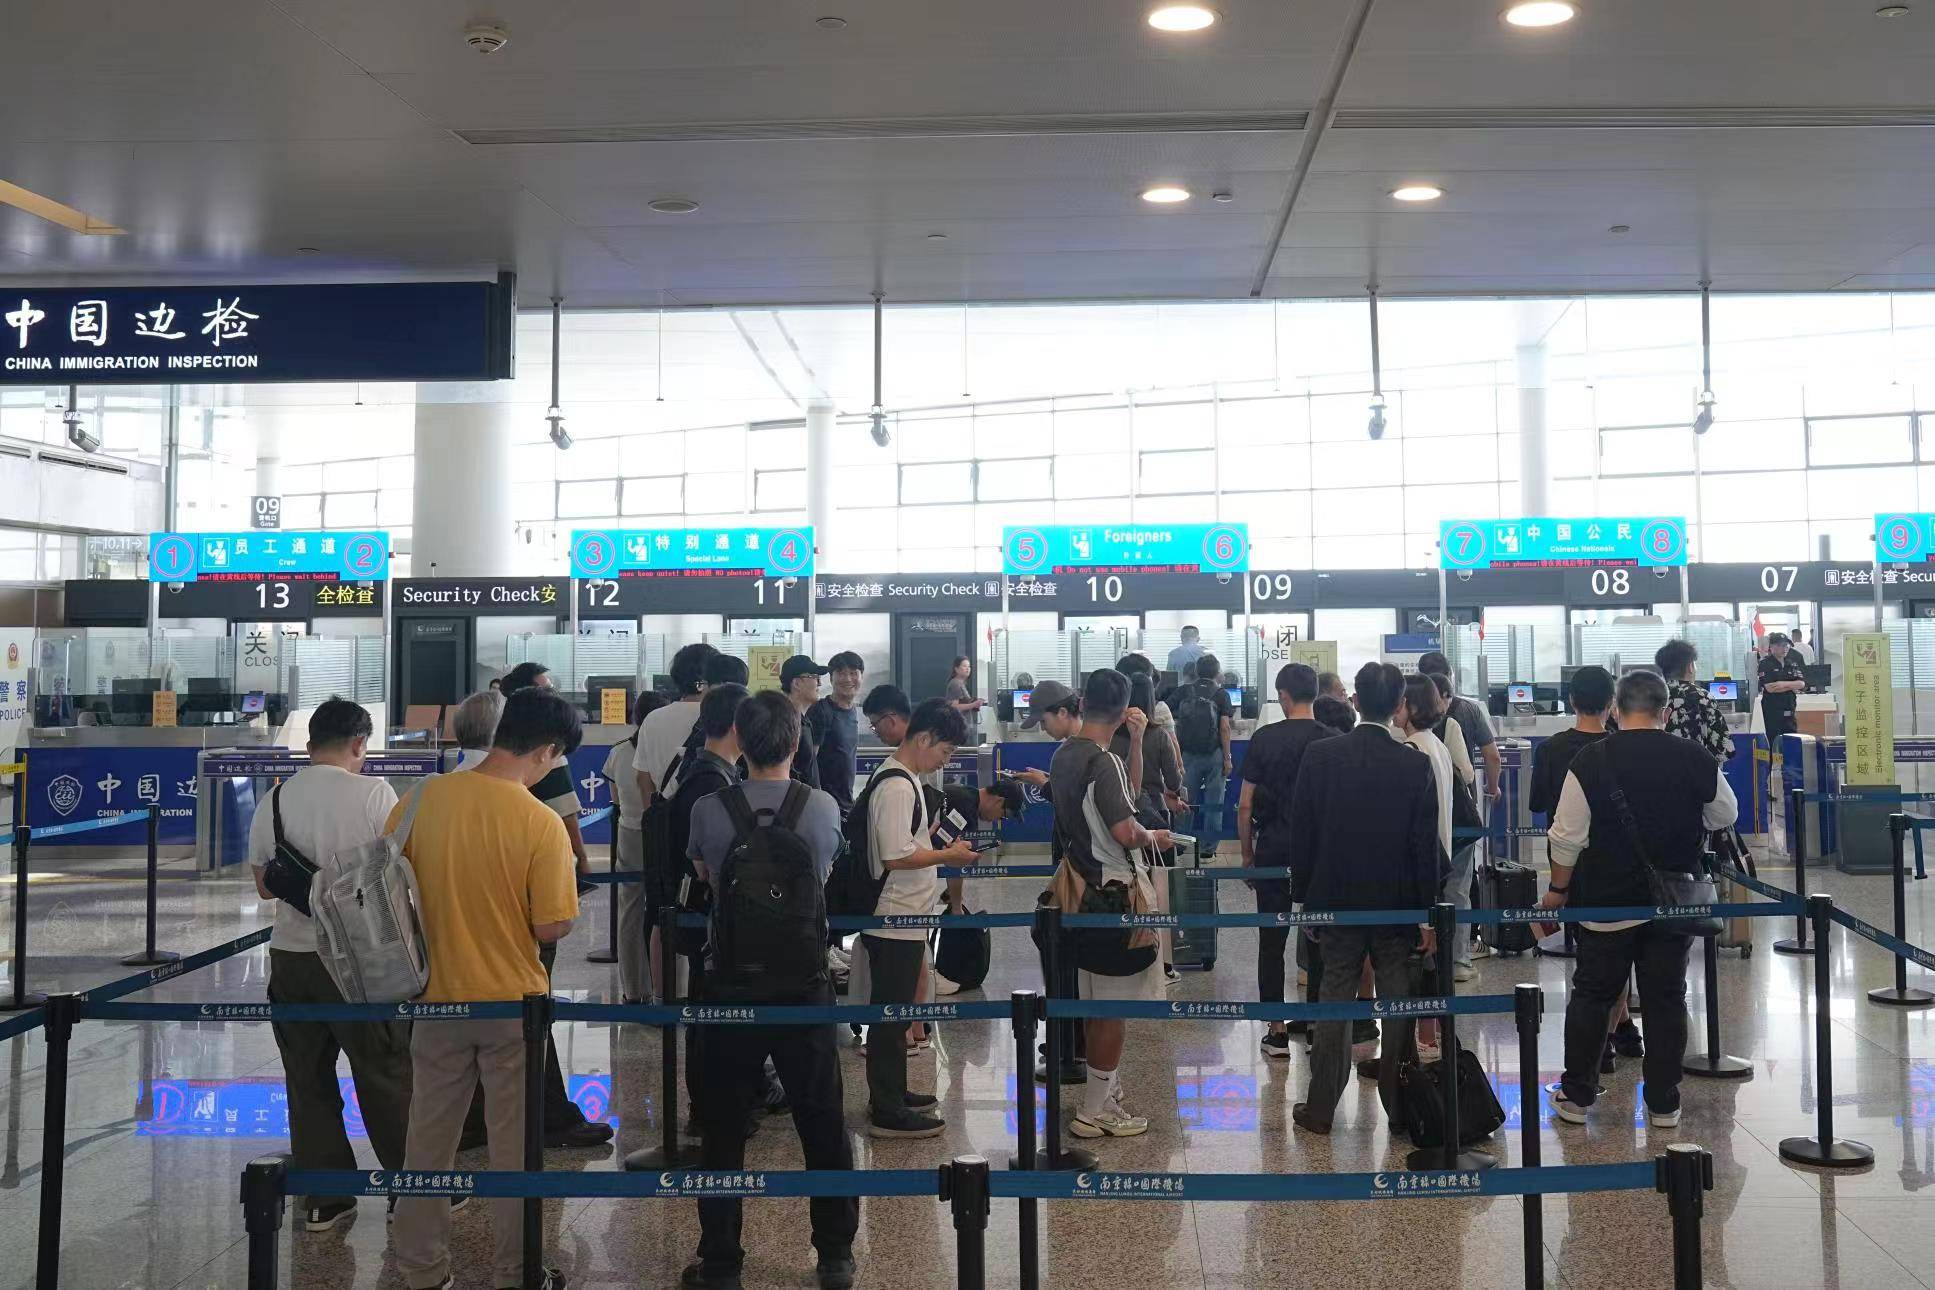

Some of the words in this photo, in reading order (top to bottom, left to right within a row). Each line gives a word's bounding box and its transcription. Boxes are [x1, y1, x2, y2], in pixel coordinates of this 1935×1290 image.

[5, 297, 259, 349] 中国边检
[5, 357, 52, 369] CHINA
[60, 356, 159, 369] IMMIGRATION
[168, 355, 258, 368] INSPECTION
[255, 497, 280, 515] 09
[655, 534, 760, 551] 特别通道
[1104, 528, 1172, 545] Foreigners
[1456, 532, 1473, 554] 7
[1527, 523, 1632, 542] 中国公民
[1653, 529, 1670, 552] 8
[1891, 525, 1908, 549] 9
[167, 547, 177, 567] 1
[235, 538, 336, 555] 员工通道
[357, 545, 372, 566] 2
[585, 541, 601, 565] 3
[780, 539, 796, 561] 4
[1018, 537, 1036, 561] 5
[1215, 535, 1232, 559] 6
[828, 583, 883, 598] 安全检查
[888, 583, 938, 598] Security
[942, 583, 980, 595] Check
[1086, 575, 1123, 602] 10
[1253, 573, 1292, 600] 09
[1591, 569, 1630, 595] 08
[1761, 566, 1799, 592] 07
[255, 583, 290, 609] 13
[316, 586, 374, 606] 全检查
[403, 586, 482, 604] Security
[585, 580, 620, 606] 12
[753, 579, 786, 605] 11
[245, 631, 299, 655] 关
[1277, 625, 1297, 648] 闭
[244, 656, 280, 667] CLOS
[0, 680, 26, 702] 警察
[1855, 672, 1870, 776] 电子监控区域
[580, 770, 605, 803] 中
[97, 809, 125, 817] CHINA
